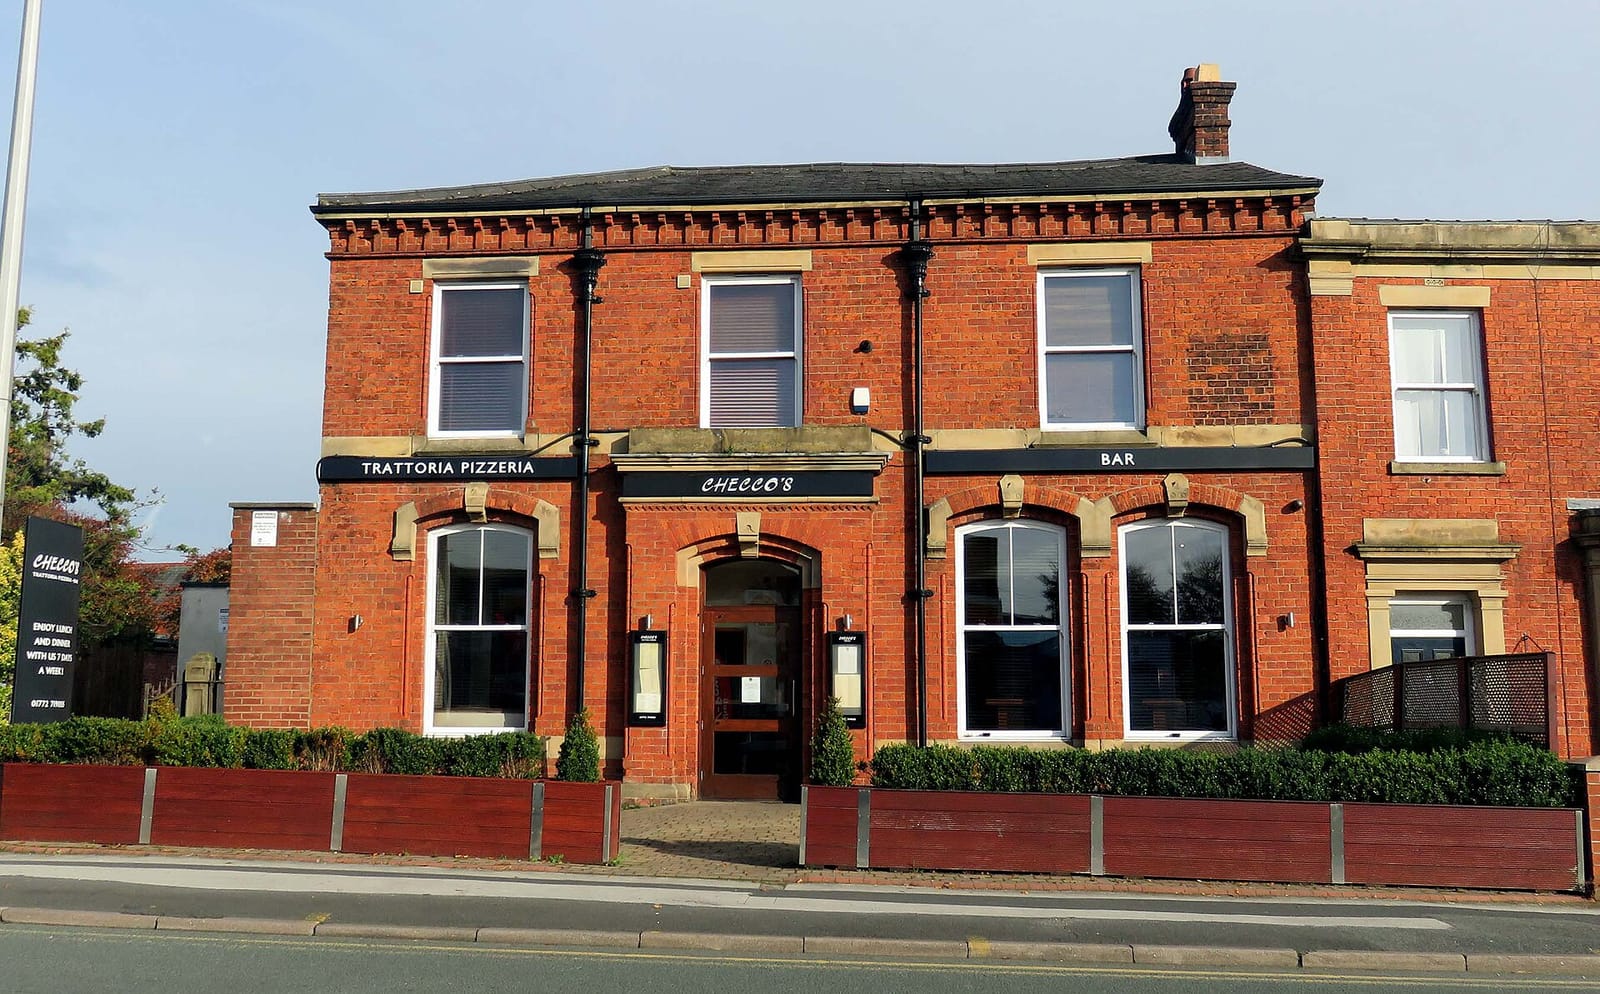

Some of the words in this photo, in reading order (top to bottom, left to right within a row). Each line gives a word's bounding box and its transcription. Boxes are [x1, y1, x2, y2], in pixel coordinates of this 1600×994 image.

[1101, 453, 1135, 466] BAR
[361, 462, 454, 475] TRATTORIA
[461, 461, 534, 474] PIZZERIA
[701, 477, 794, 493] CHECCO'S
[33, 554, 80, 575] CHECCO'S
[33, 622, 56, 632] ENJOY
[33, 637, 51, 646] AND
[26, 651, 47, 660] WITH
[48, 652, 57, 661] US
[38, 666, 45, 675] A
